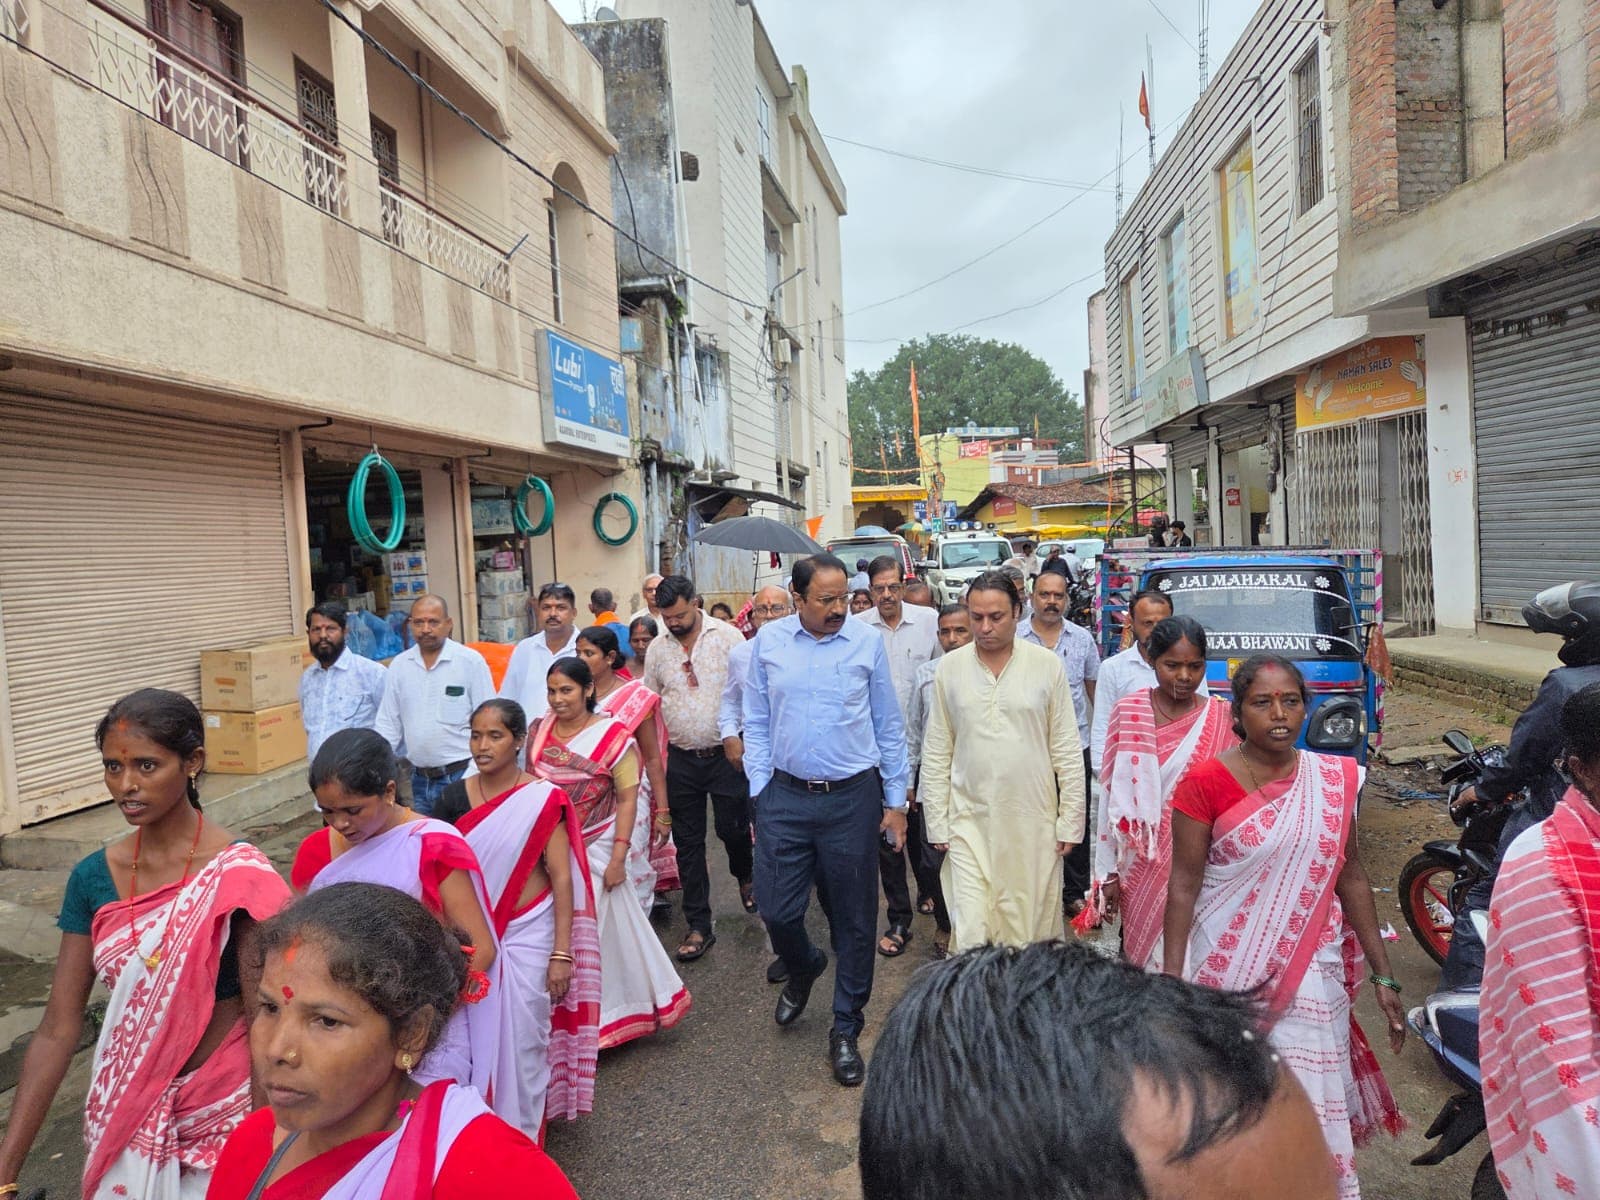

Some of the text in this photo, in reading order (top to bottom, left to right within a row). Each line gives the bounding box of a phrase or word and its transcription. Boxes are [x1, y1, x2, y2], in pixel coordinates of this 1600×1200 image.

[555, 346, 582, 379] Lubi
[1337, 357, 1393, 380] NAMAN SALES
[1345, 379, 1385, 394] Welcome
[1179, 575, 1208, 588] JAI
[1206, 636, 1311, 651] MAA BHAWANI
